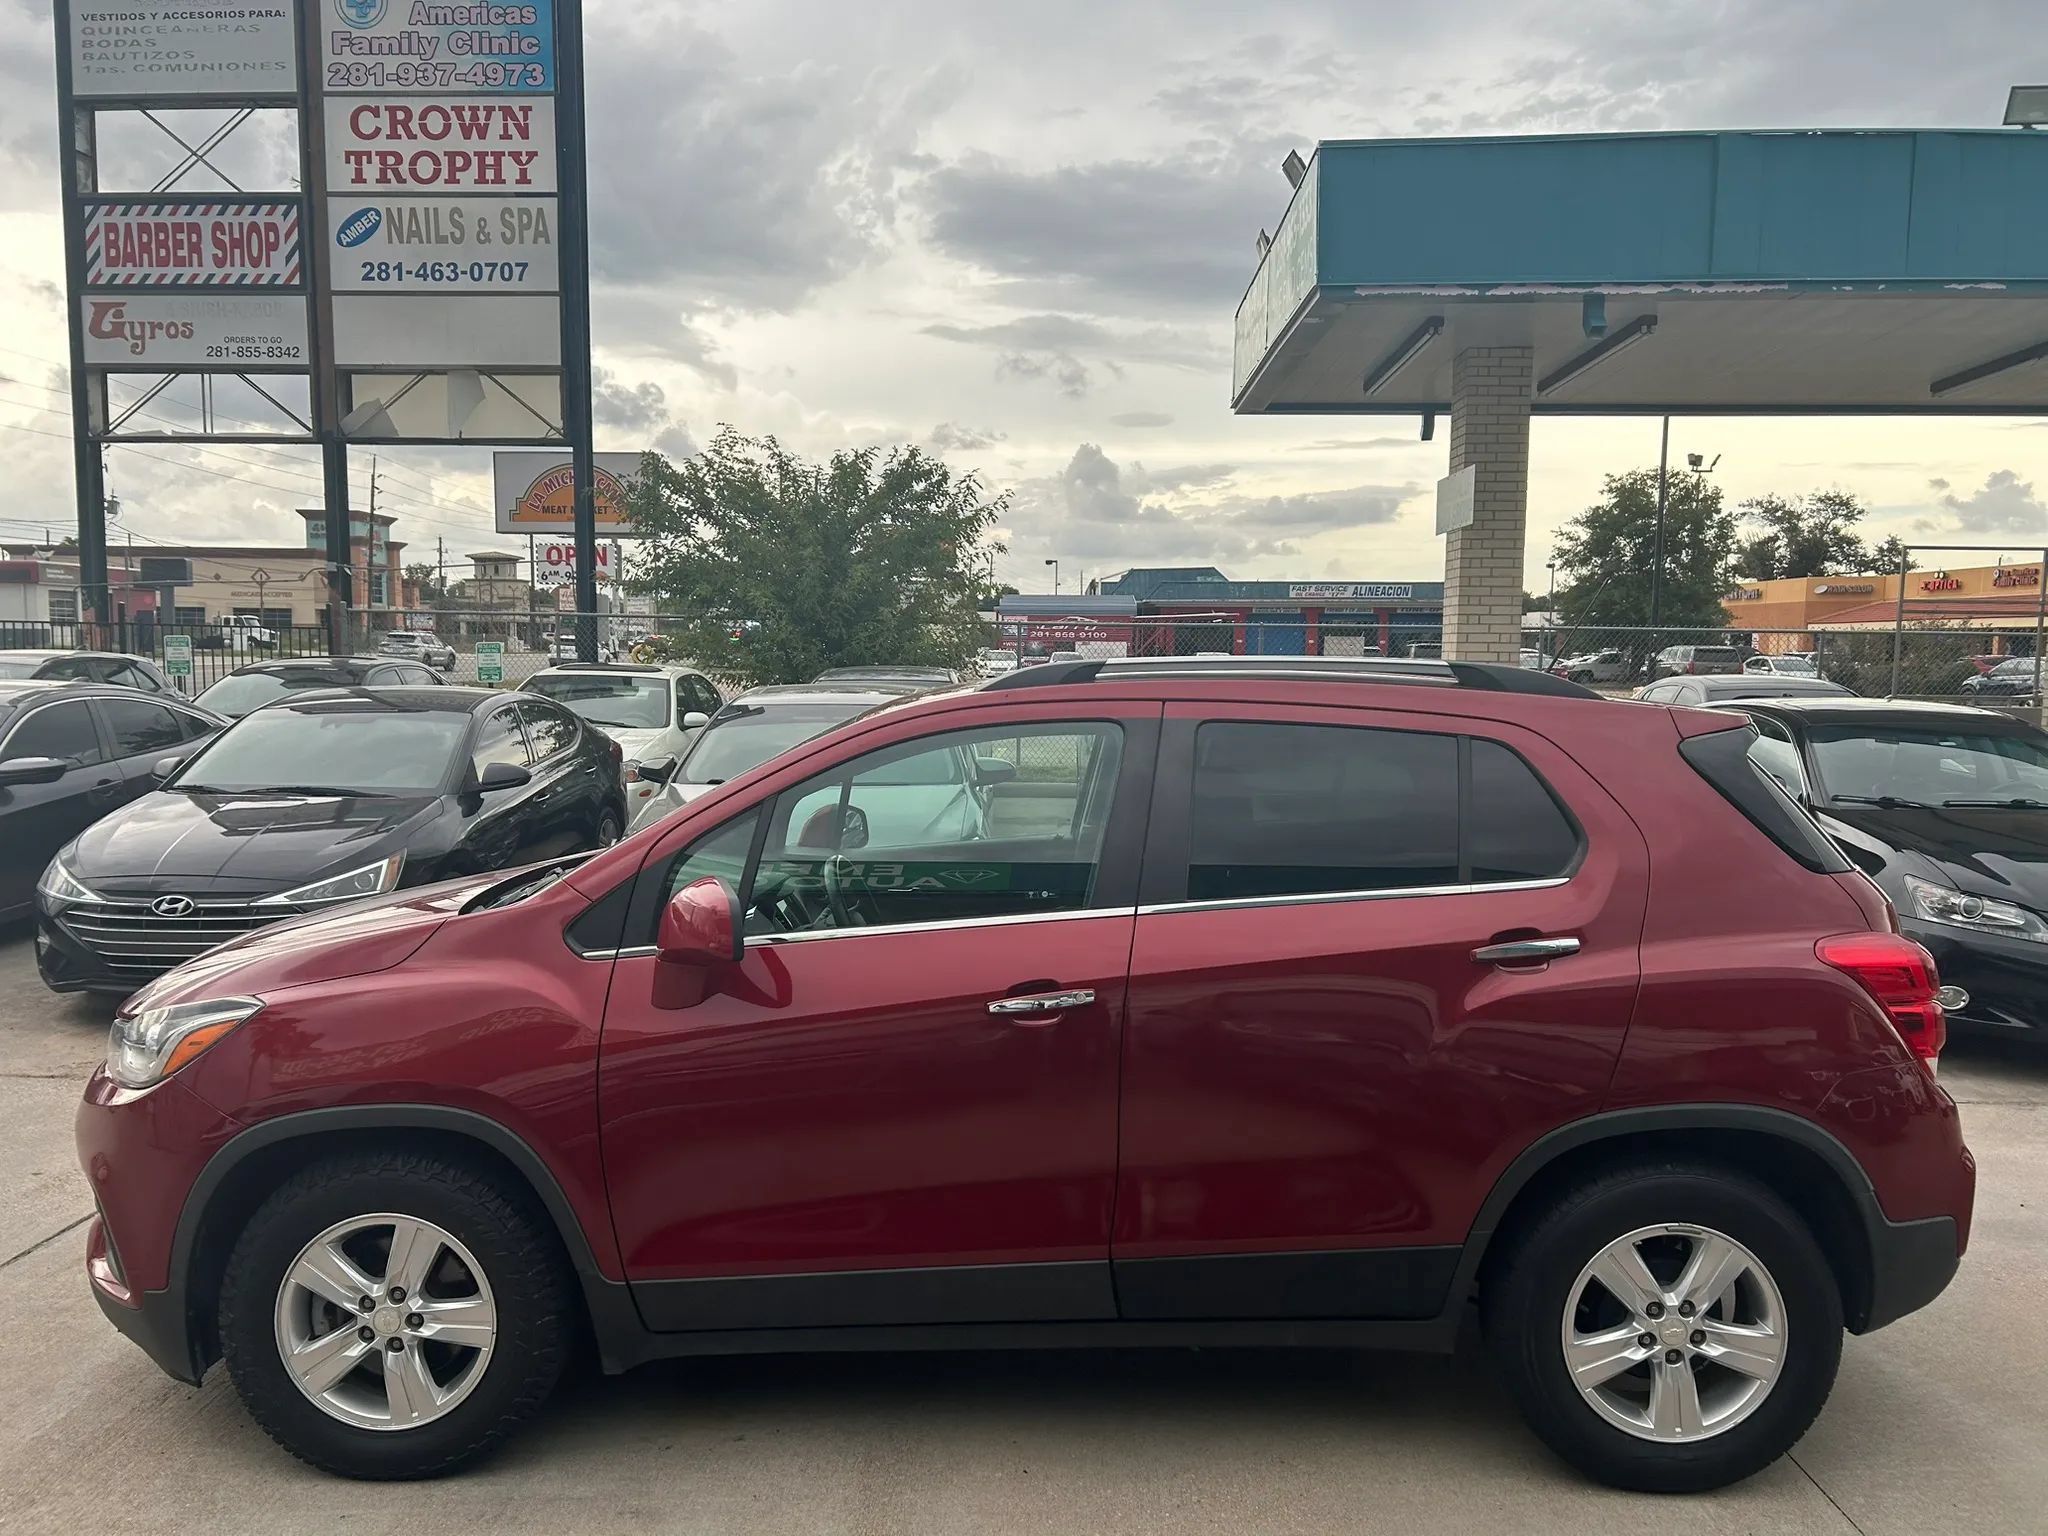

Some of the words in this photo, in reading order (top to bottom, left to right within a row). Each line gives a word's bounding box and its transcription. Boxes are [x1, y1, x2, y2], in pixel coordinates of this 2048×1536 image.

[81, 12, 146, 22] VESTIDOS
[150, 12, 159, 21] Y
[162, 10, 246, 20] ACCESORIOS
[248, 10, 287, 19] PARA:
[408, 1, 538, 26] Americas
[81, 38, 158, 49] BODAS
[331, 31, 440, 60] Family
[447, 31, 541, 56] Clinic
[82, 50, 196, 61] BAUTIZOS
[132, 61, 288, 73] COMUNIONES
[327, 62, 545, 87] 281-937-4973
[349, 105, 533, 141] CROWN
[344, 150, 539, 185] TROPHY
[339, 209, 381, 247] AMBER
[385, 206, 466, 245] NAILS
[476, 216, 492, 245] &
[500, 206, 551, 245] SPA
[103, 221, 204, 269] BARBER
[210, 220, 281, 269] SHOP
[360, 261, 530, 283] 281-463-0707
[88, 301, 194, 356] Gyros
[223, 336, 256, 344] ORDERS
[257, 336, 269, 344] TO
[270, 336, 282, 344] GO
[206, 345, 300, 358] 281-855-8342
[527, 491, 547, 512] LA
[542, 505, 567, 514] MEAT
[546, 545, 608, 567] OPN
[1351, 585, 1411, 597] ALINEACION
